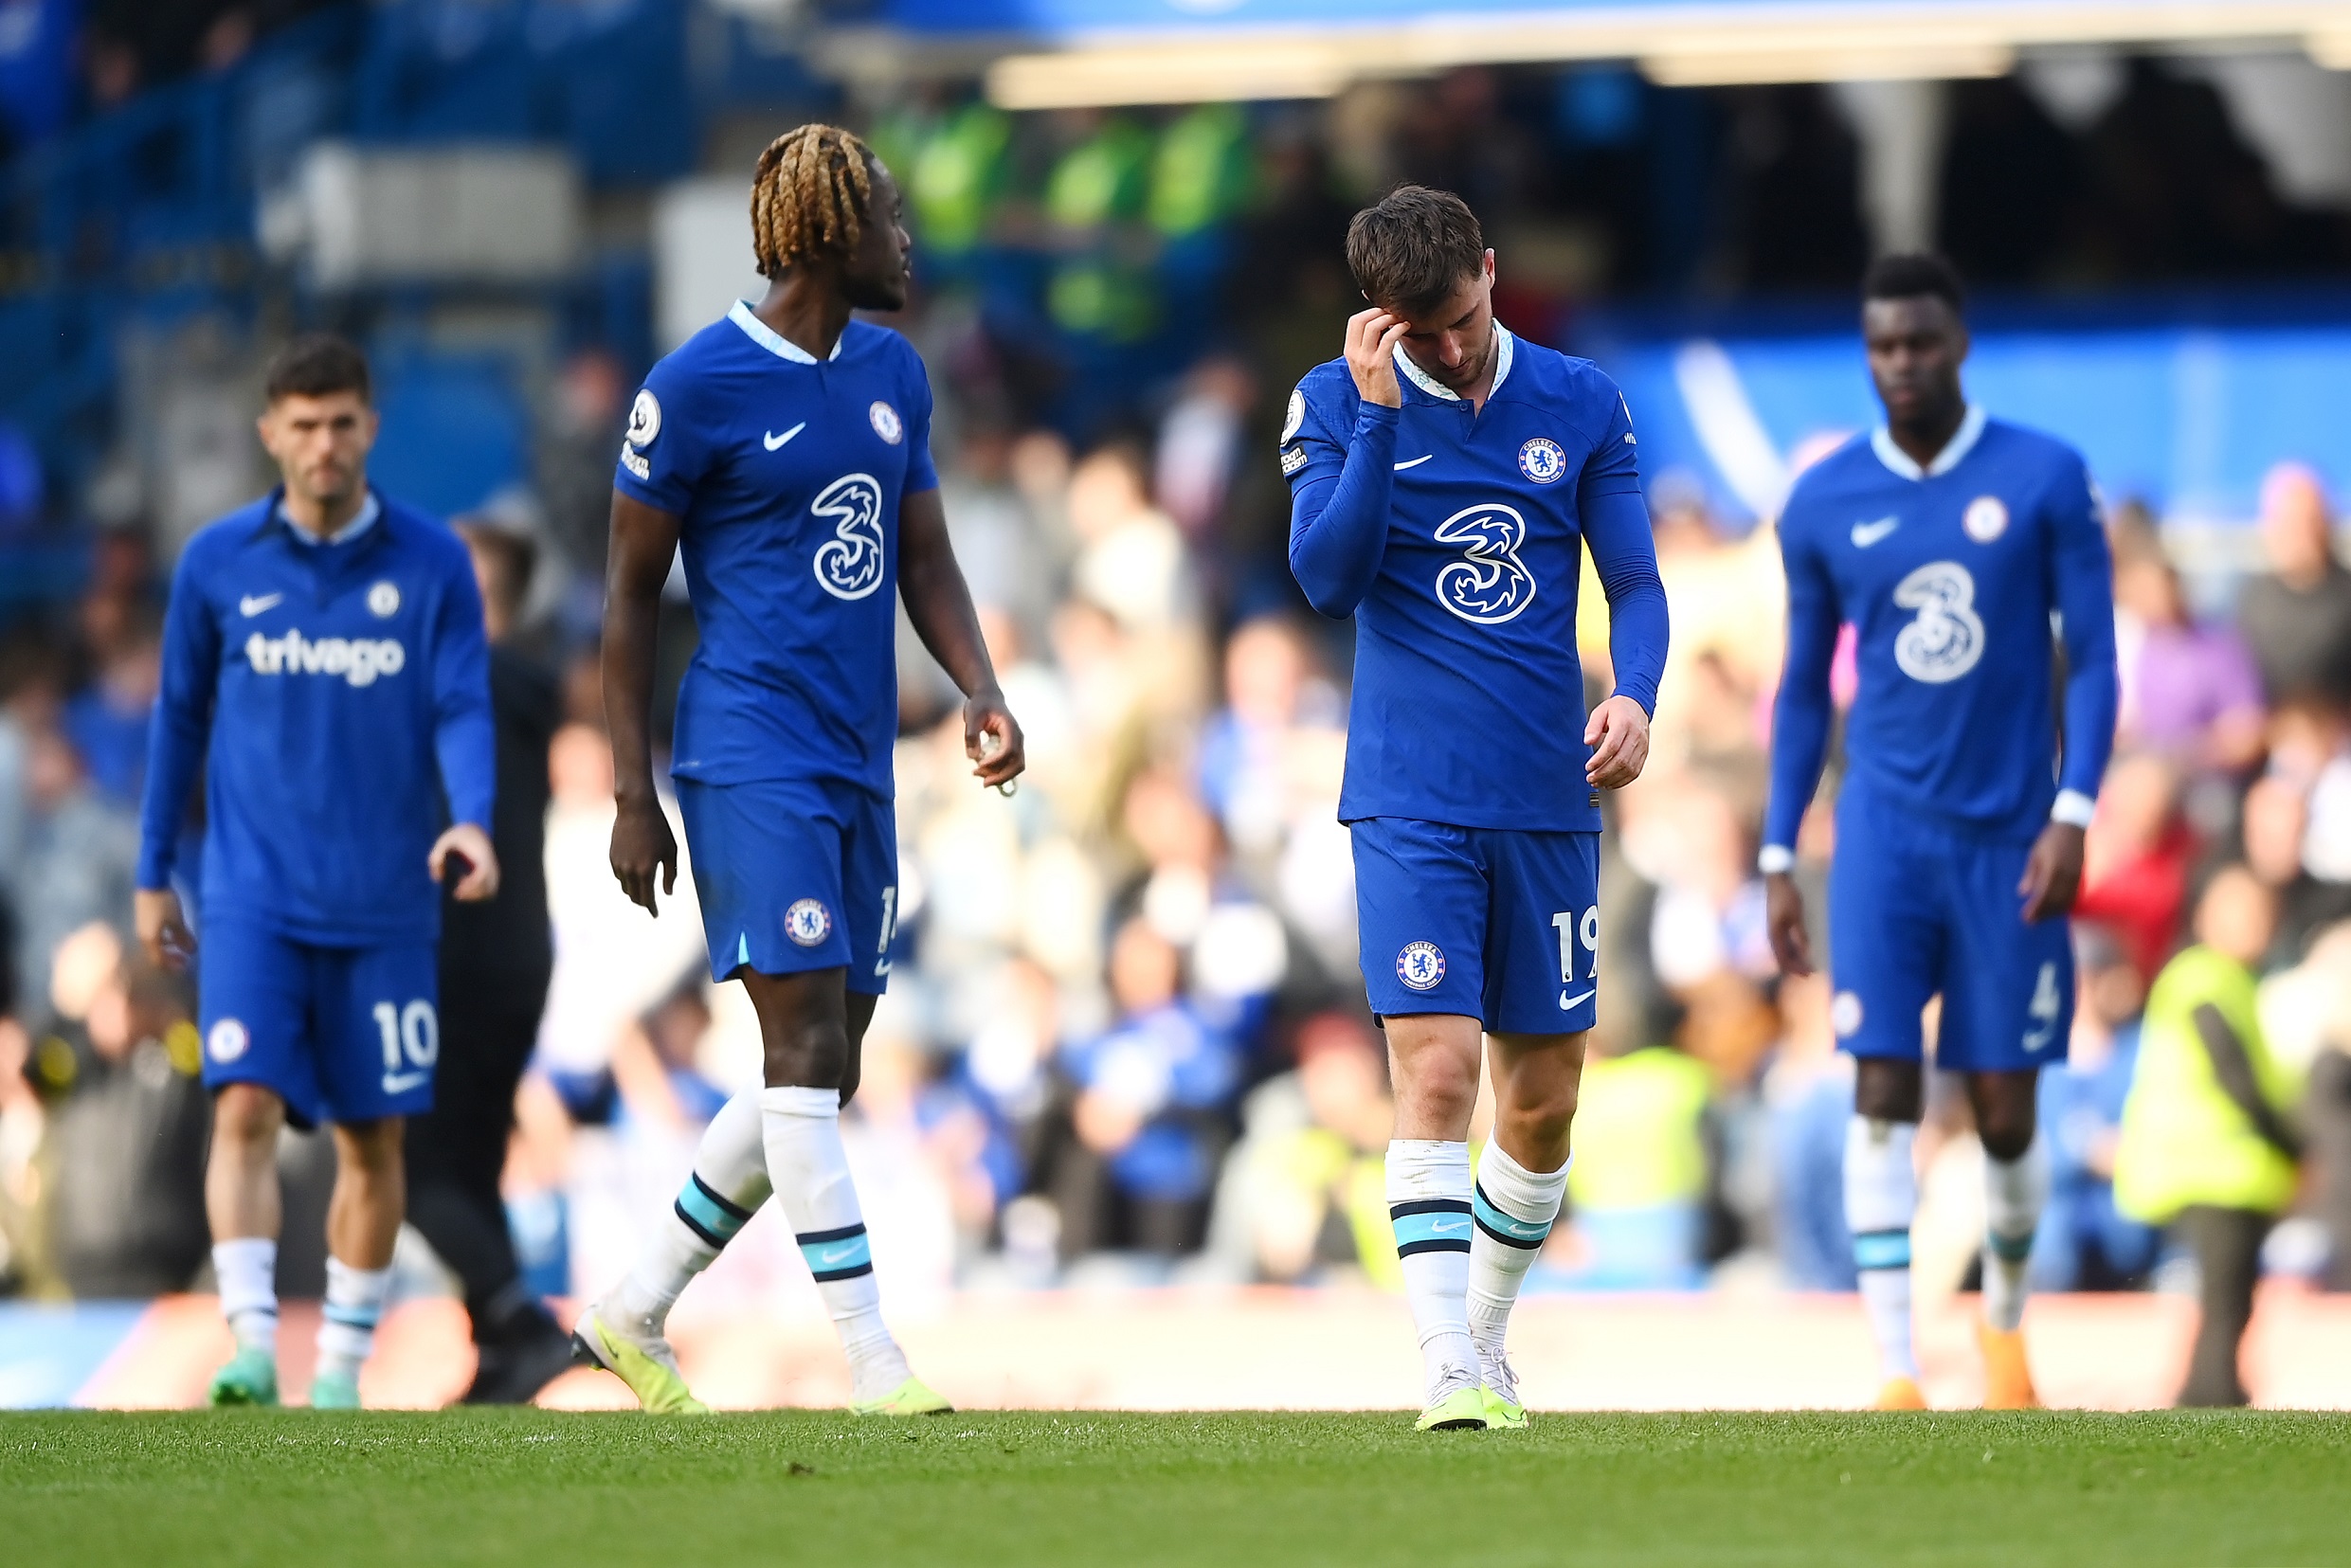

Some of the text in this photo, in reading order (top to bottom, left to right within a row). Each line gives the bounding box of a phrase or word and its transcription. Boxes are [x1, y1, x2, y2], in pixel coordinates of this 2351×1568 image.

[1524, 440, 1554, 451] CHELSEA
[811, 473, 884, 601] 3
[1434, 503, 1536, 624] 3
[244, 627, 406, 689] trivago
[877, 886, 897, 954] 1
[1404, 943, 1437, 954] CHELSEA
[1551, 905, 1599, 983] 19
[372, 999, 440, 1070] 10
